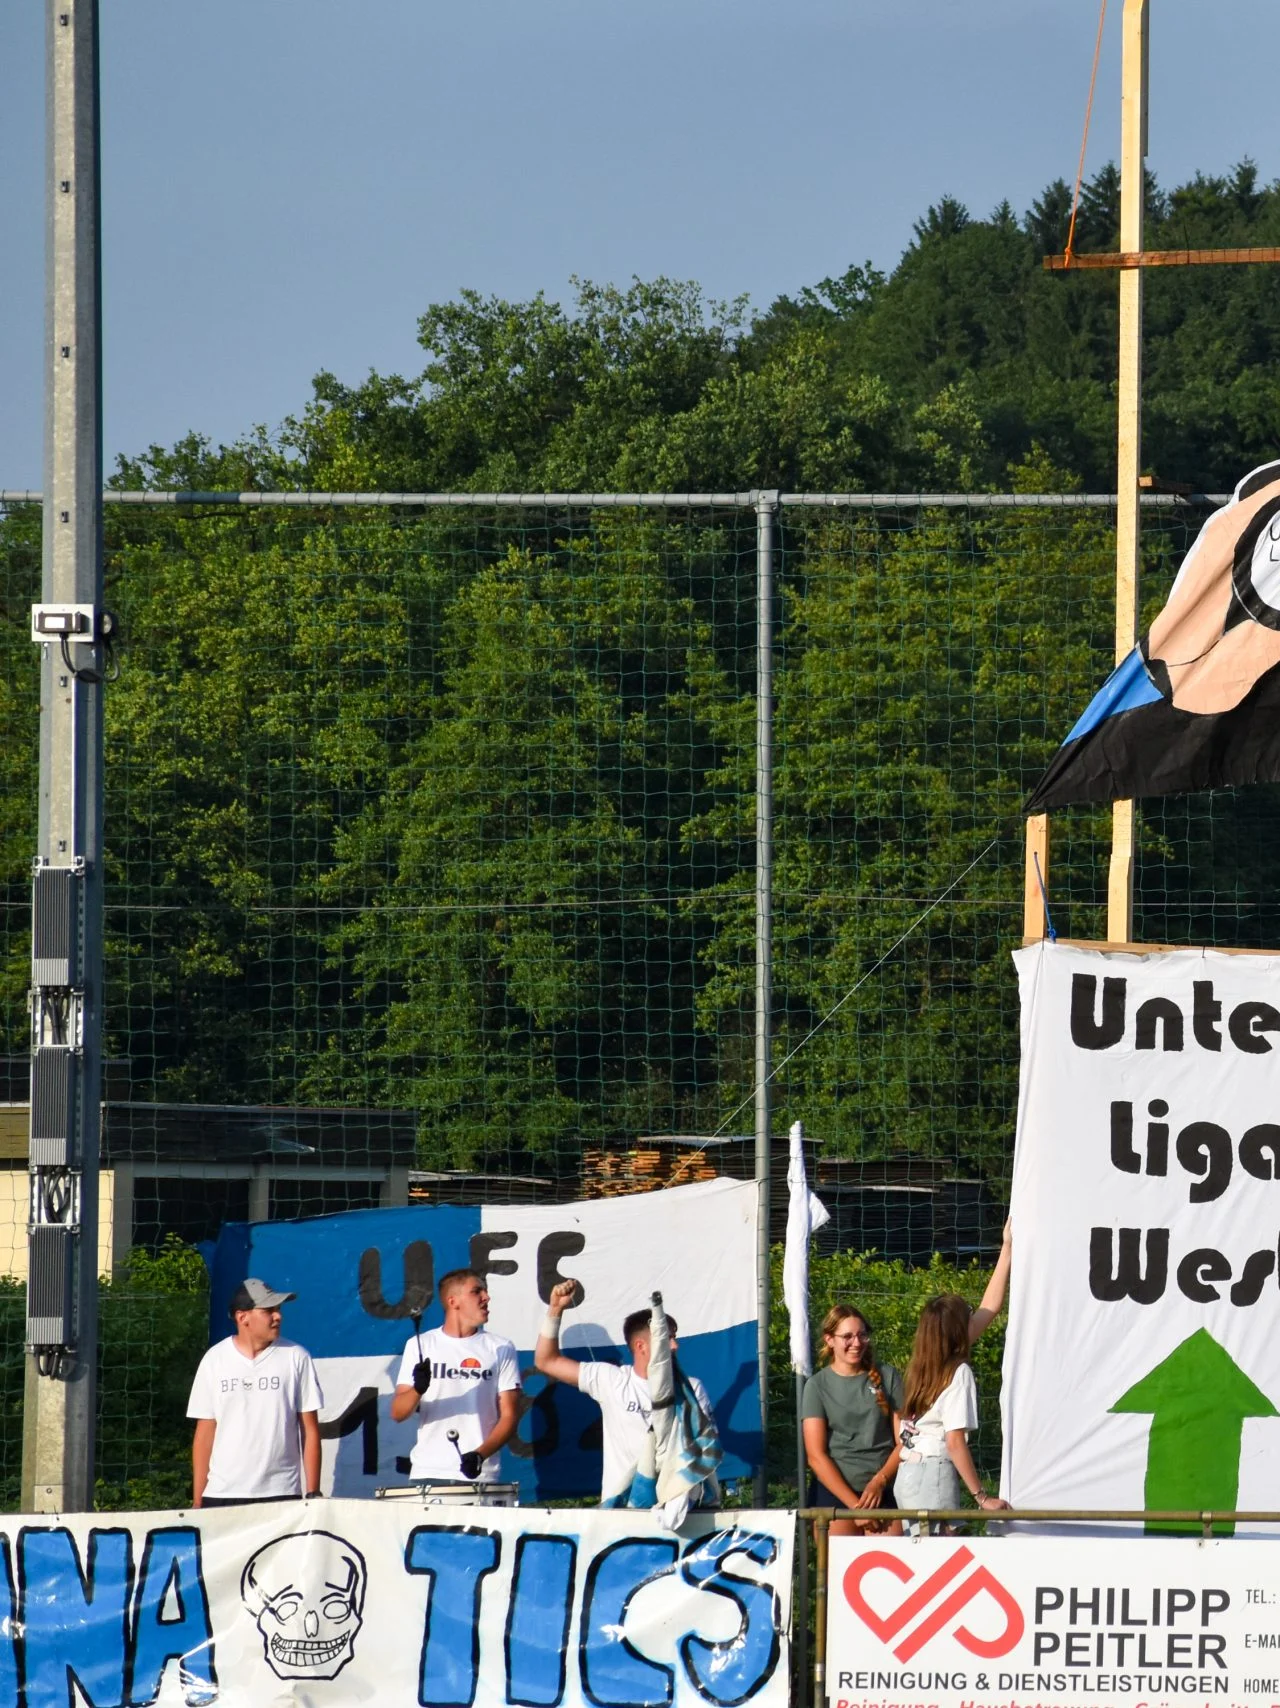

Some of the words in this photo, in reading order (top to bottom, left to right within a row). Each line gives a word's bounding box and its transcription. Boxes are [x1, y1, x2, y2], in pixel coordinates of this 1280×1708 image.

[432, 1362, 493, 1381] llesse
[220, 1378, 239, 1393] BF
[258, 1376, 280, 1391] 09
[1034, 1586, 1231, 1627] PHILIPP
[1245, 1588, 1276, 1604] TEL.:
[0, 1525, 219, 1708] NA
[404, 1523, 782, 1708] TICS
[1033, 1631, 1228, 1669] PEITLER
[838, 1671, 967, 1691] REINIGUNG
[975, 1672, 990, 1691] &
[999, 1673, 1229, 1693] DIENSTLEISTUNGEN
